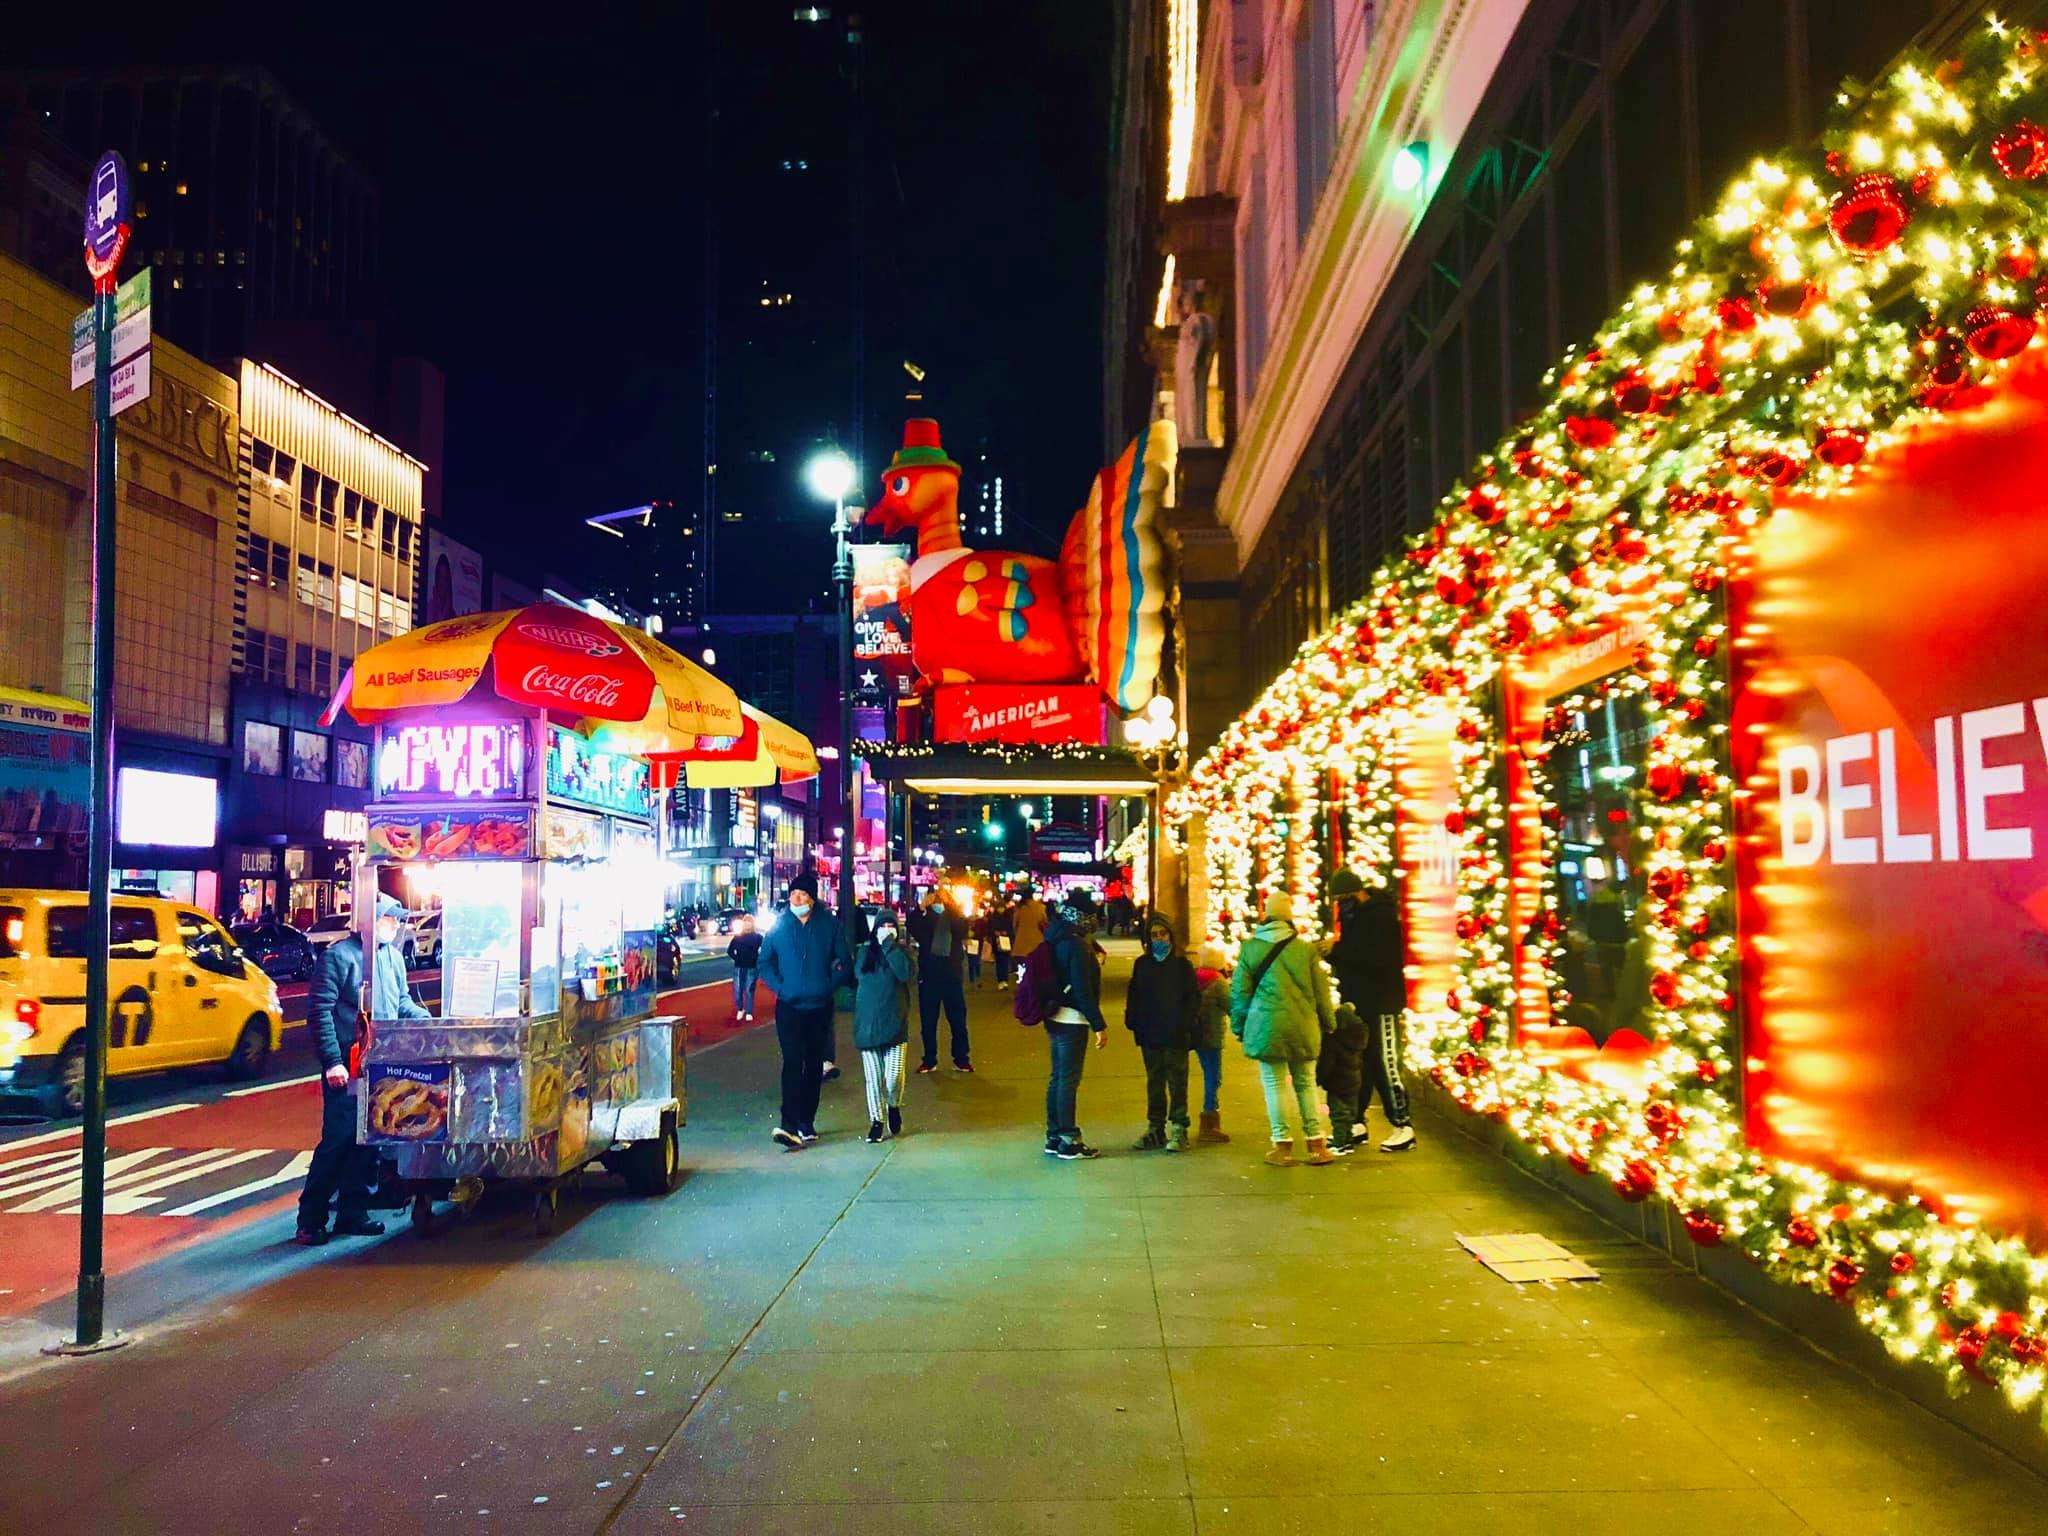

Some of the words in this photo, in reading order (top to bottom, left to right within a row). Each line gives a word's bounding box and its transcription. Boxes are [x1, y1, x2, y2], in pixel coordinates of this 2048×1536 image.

[532, 626, 597, 648] NIKAS
[854, 621, 888, 634] GIVE.
[864, 632, 902, 643] LOVE.
[856, 643, 912, 655] BELIEVE.
[365, 673, 384, 687] All
[387, 668, 414, 686] Beef
[417, 666, 480, 682] Sausages
[674, 698, 693, 713] Beef
[695, 700, 710, 715] Hot
[970, 696, 1059, 733] AMERICAN
[1778, 697, 2048, 867] BELIE
[675, 780, 687, 813] NAVY
[386, 1066, 402, 1076] Hot
[404, 1068, 432, 1081] Pretzel
